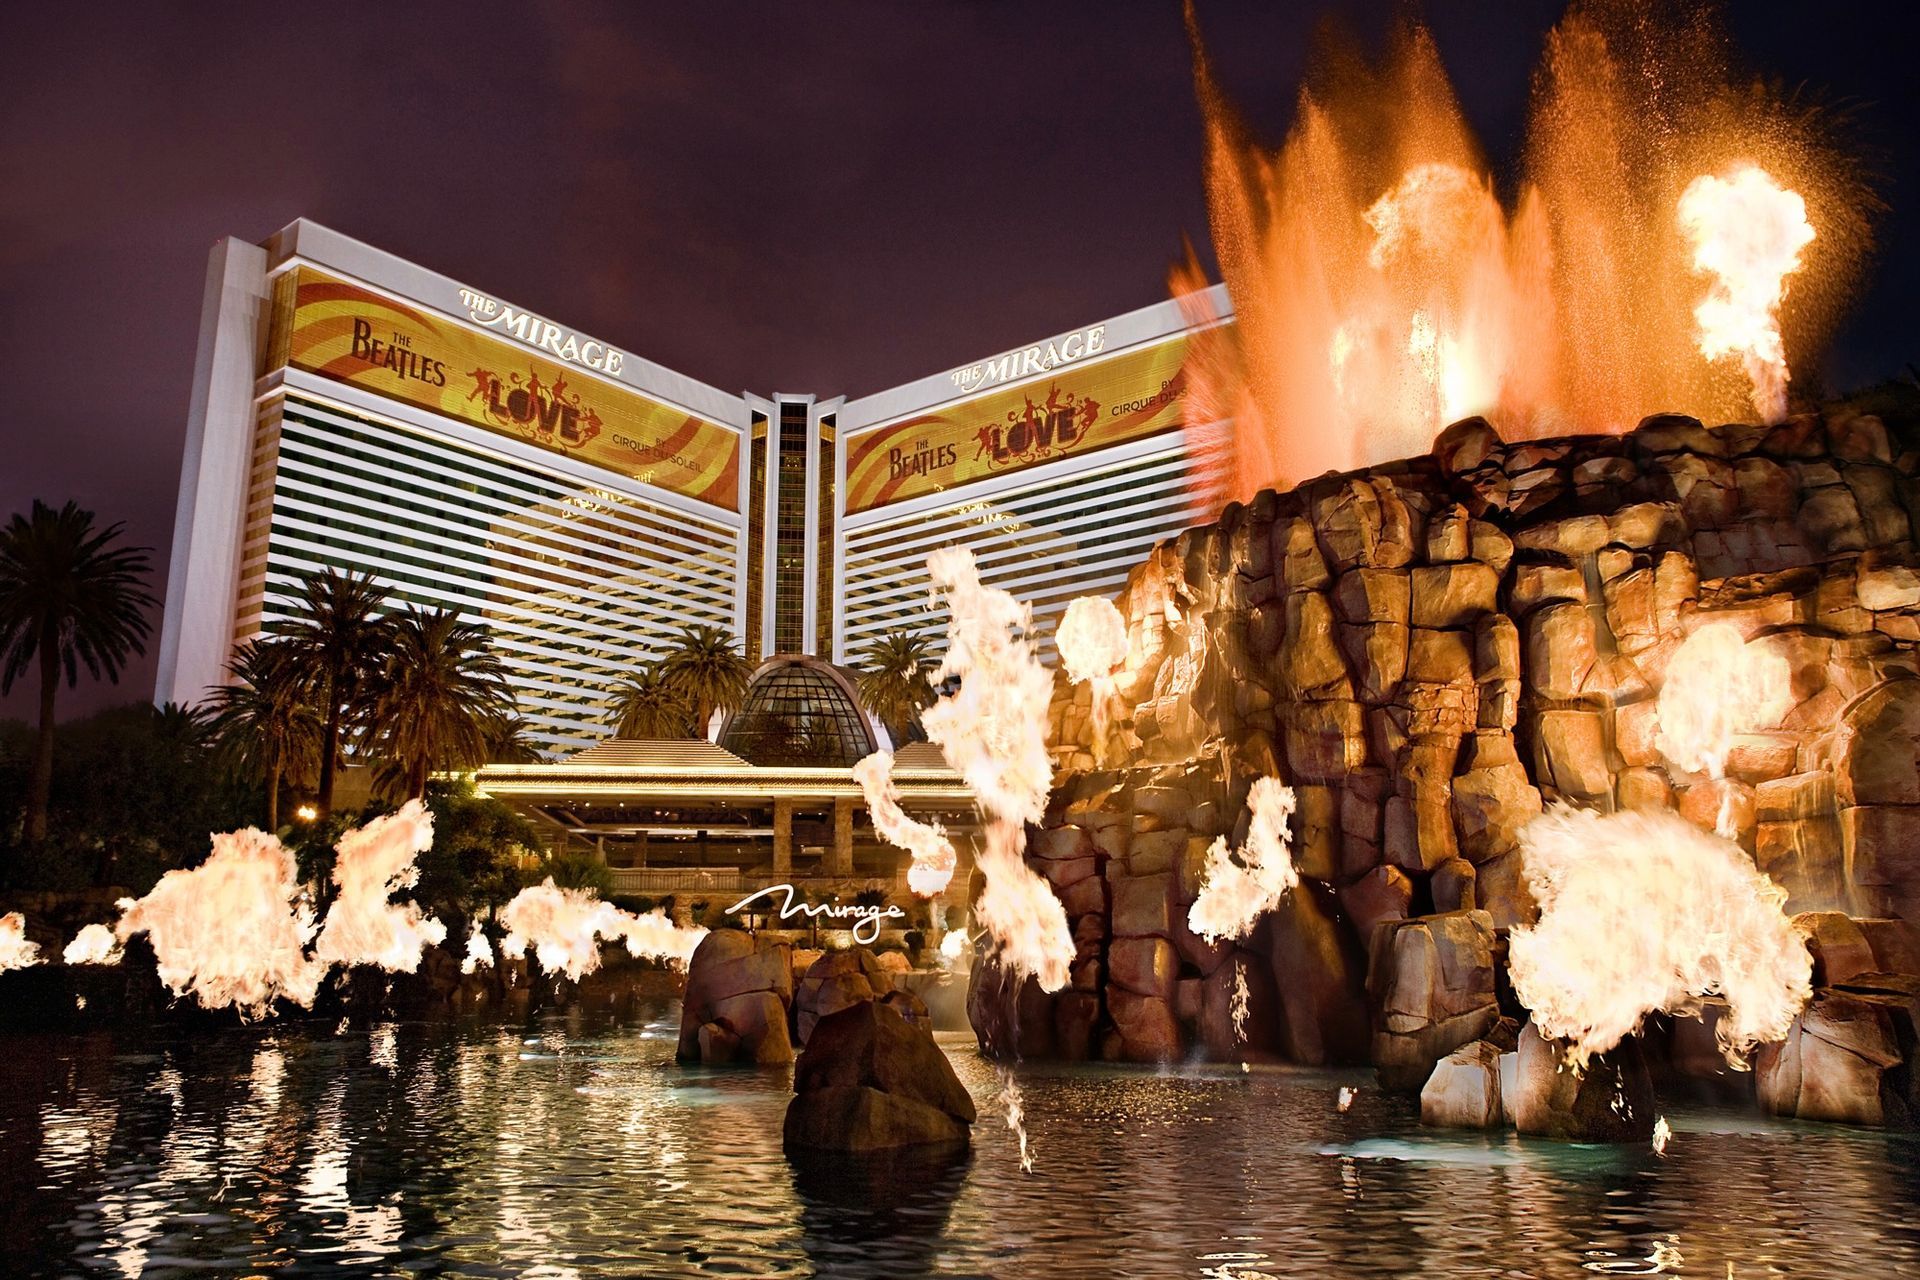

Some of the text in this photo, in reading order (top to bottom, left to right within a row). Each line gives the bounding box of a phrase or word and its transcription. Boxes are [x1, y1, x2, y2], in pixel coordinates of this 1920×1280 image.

[393, 331, 412, 347] THE
[459, 289, 624, 376] THE MIRAGE
[951, 325, 1105, 393] THE MIRAGE
[1111, 395, 1157, 416] CIRQUE
[1160, 391, 1178, 403] DU
[1161, 379, 1175, 390] BY
[489, 378, 582, 442] LOVE
[655, 437, 666, 448] BY
[916, 438, 929, 451] THE
[991, 406, 1078, 461] LOVE
[612, 433, 704, 474] CIRQUE DU SOLEIL
[889, 443, 957, 481] BEATLES
